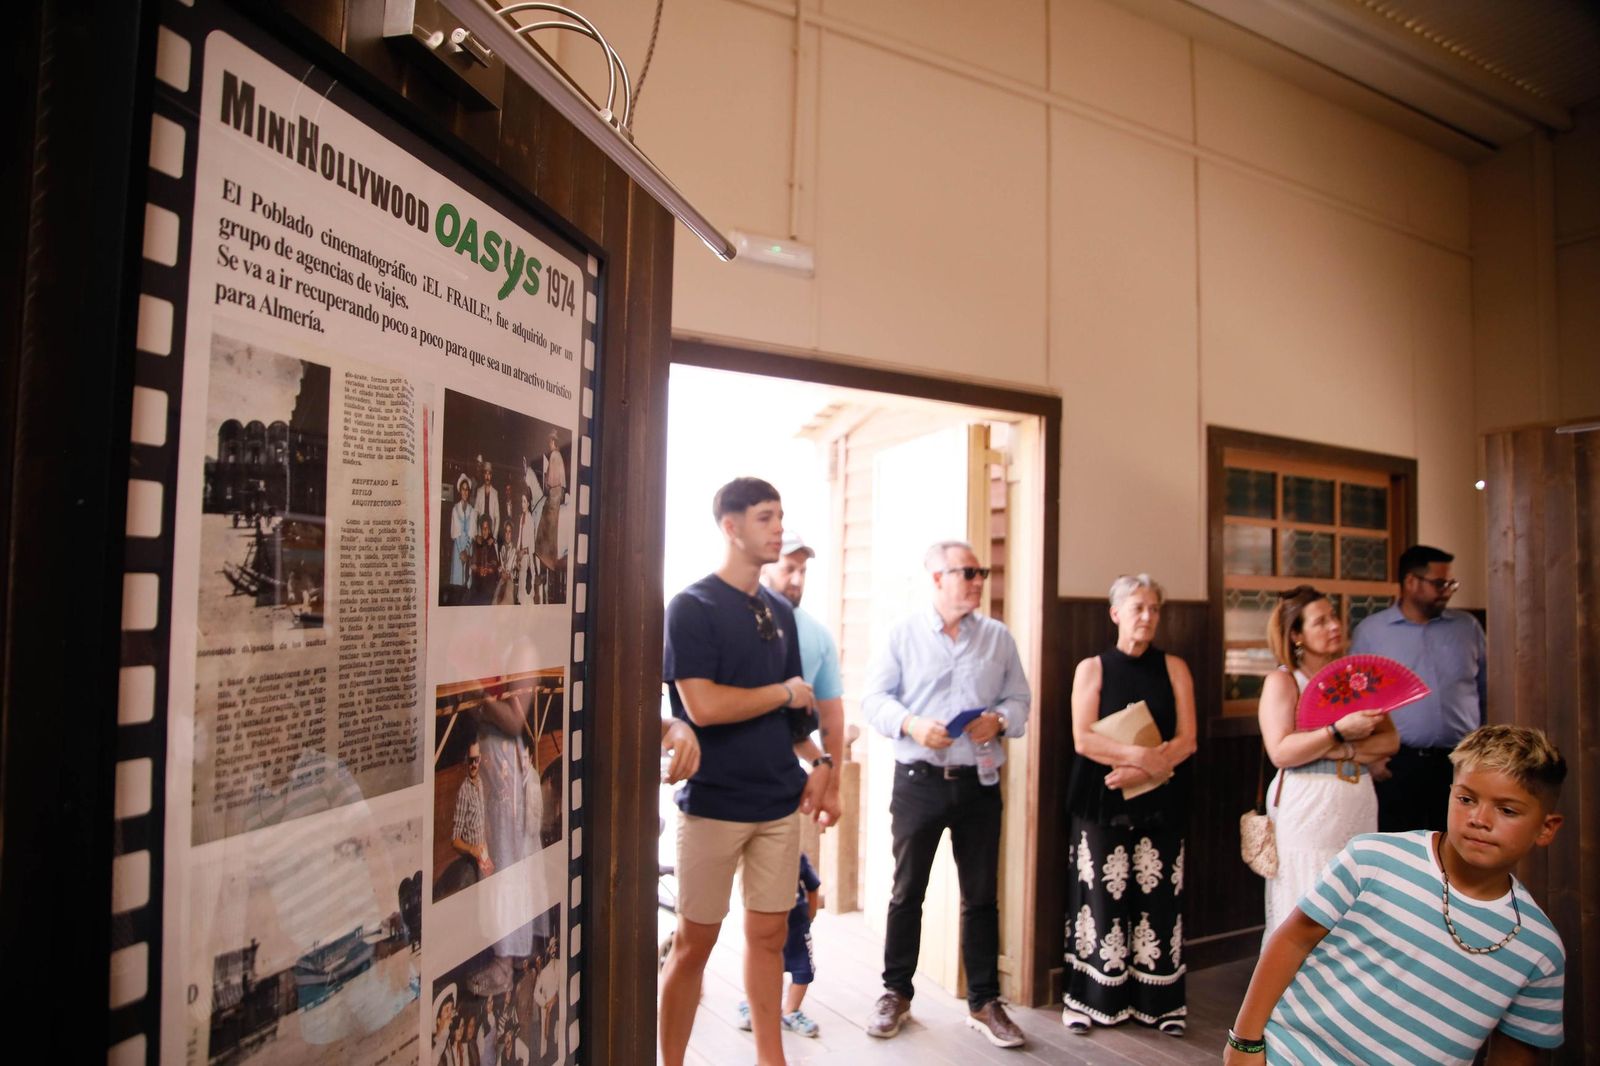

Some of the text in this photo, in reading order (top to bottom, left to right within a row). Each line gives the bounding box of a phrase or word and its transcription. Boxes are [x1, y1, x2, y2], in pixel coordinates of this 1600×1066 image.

[218, 217, 409, 310] grupo de agencias de viajes.
[221, 178, 241, 206] El
[250, 190, 314, 239] Poblado
[321, 228, 417, 288] cinematográfico
[446, 286, 493, 326] FRAILE!,
[496, 312, 509, 330] fue
[512, 321, 548, 349] adquirido
[550, 341, 562, 356] por
[565, 348, 574, 361] un
[215, 282, 325, 333] para Almería.
[217, 243, 239, 271] Se
[242, 259, 262, 280] va
[266, 268, 275, 285] a
[279, 267, 293, 290] ir
[295, 279, 379, 324] recuperando
[382, 312, 409, 335] poco
[411, 326, 417, 339] a
[420, 329, 443, 350] poco
[445, 339, 467, 359] para
[469, 350, 486, 366] que
[487, 355, 500, 372] sea
[501, 361, 512, 377] un
[513, 365, 545, 390] atractivo
[546, 265, 575, 317] 1974
[351, 488, 373, 496] ESTILO
[352, 478, 388, 486] RESPETANDO
